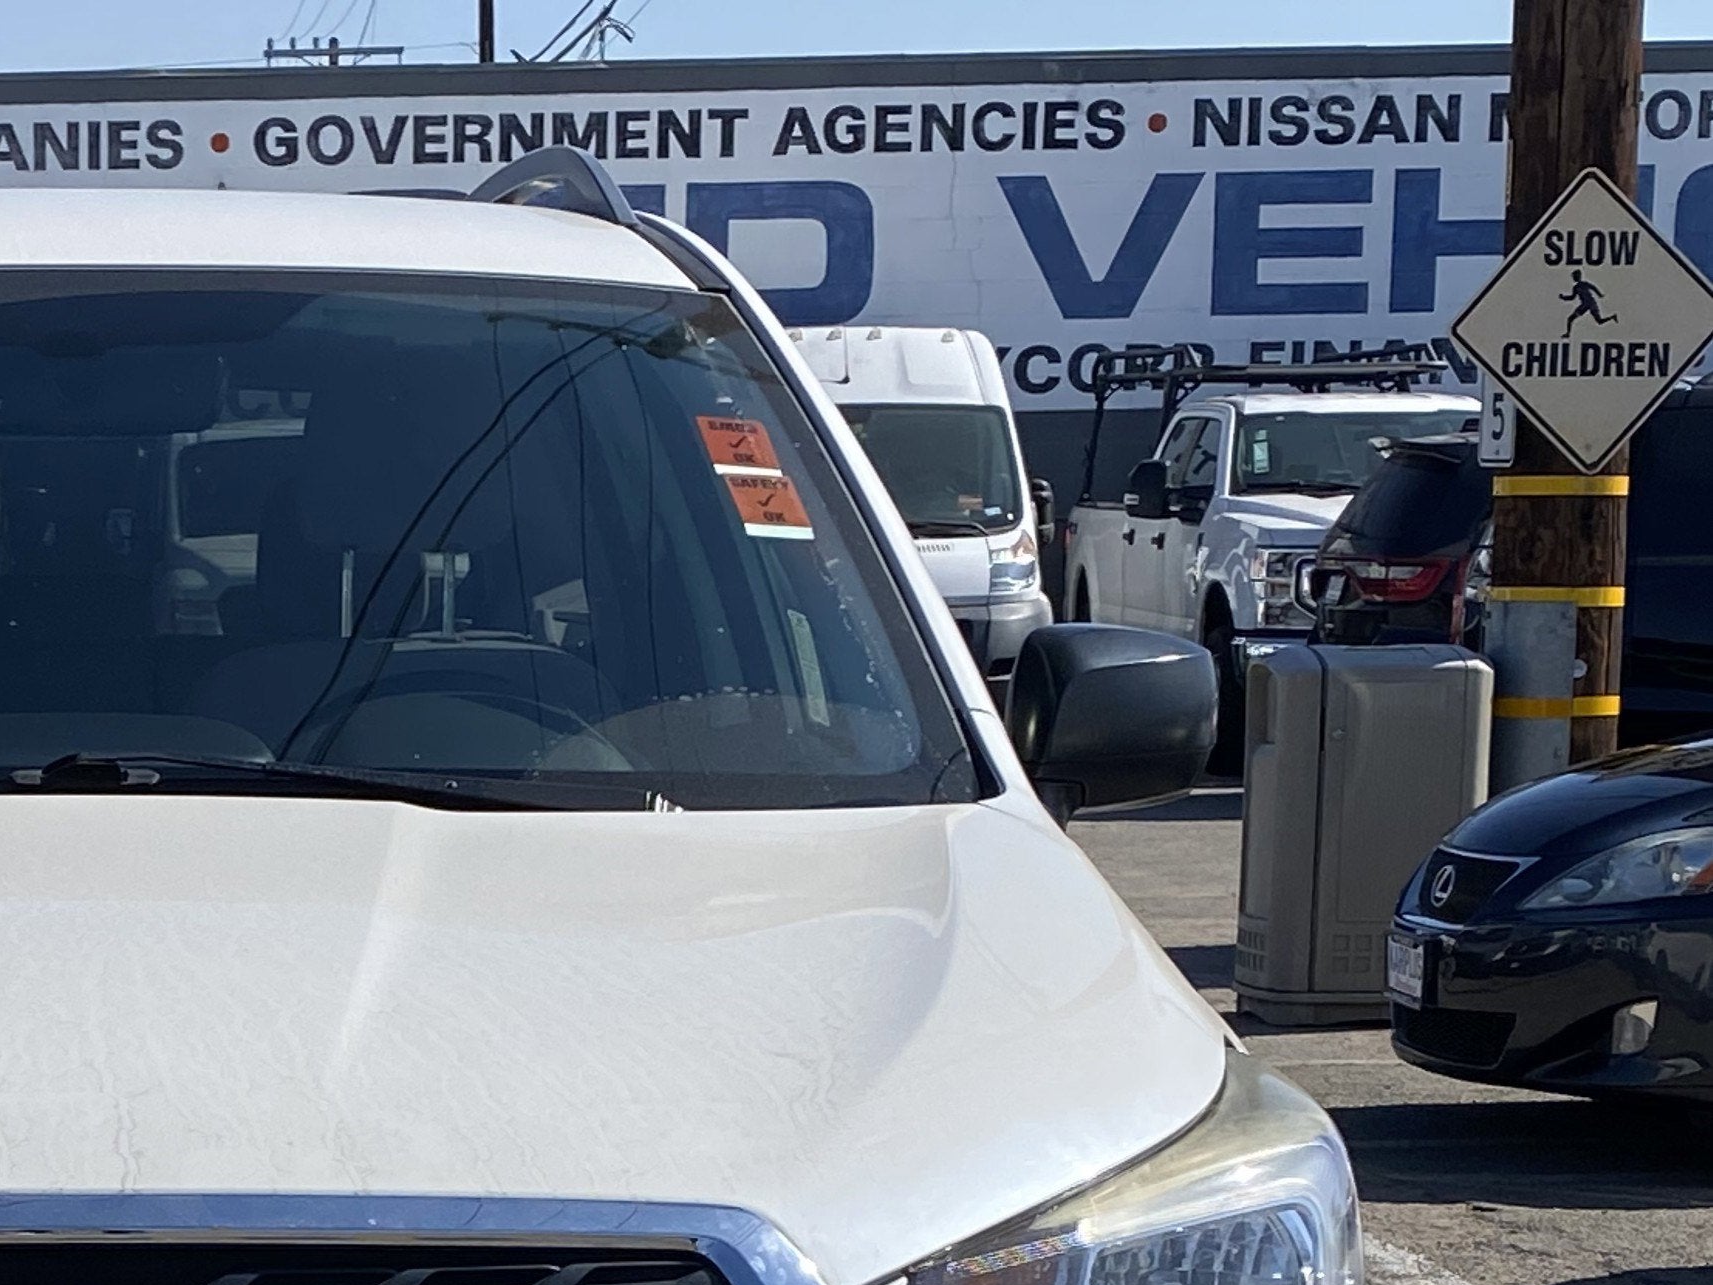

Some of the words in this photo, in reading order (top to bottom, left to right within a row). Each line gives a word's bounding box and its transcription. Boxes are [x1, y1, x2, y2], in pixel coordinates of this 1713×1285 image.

[253, 107, 749, 166] GOVERNMENT
[772, 98, 1126, 156] AGENCIES
[1192, 93, 1462, 147] NISSAN
[1544, 230, 1640, 267] SLOW
[1501, 341, 1671, 378] CHILDREN
[1491, 392, 1505, 440] 5
[733, 453, 756, 464] OK
[763, 511, 786, 522] OK
